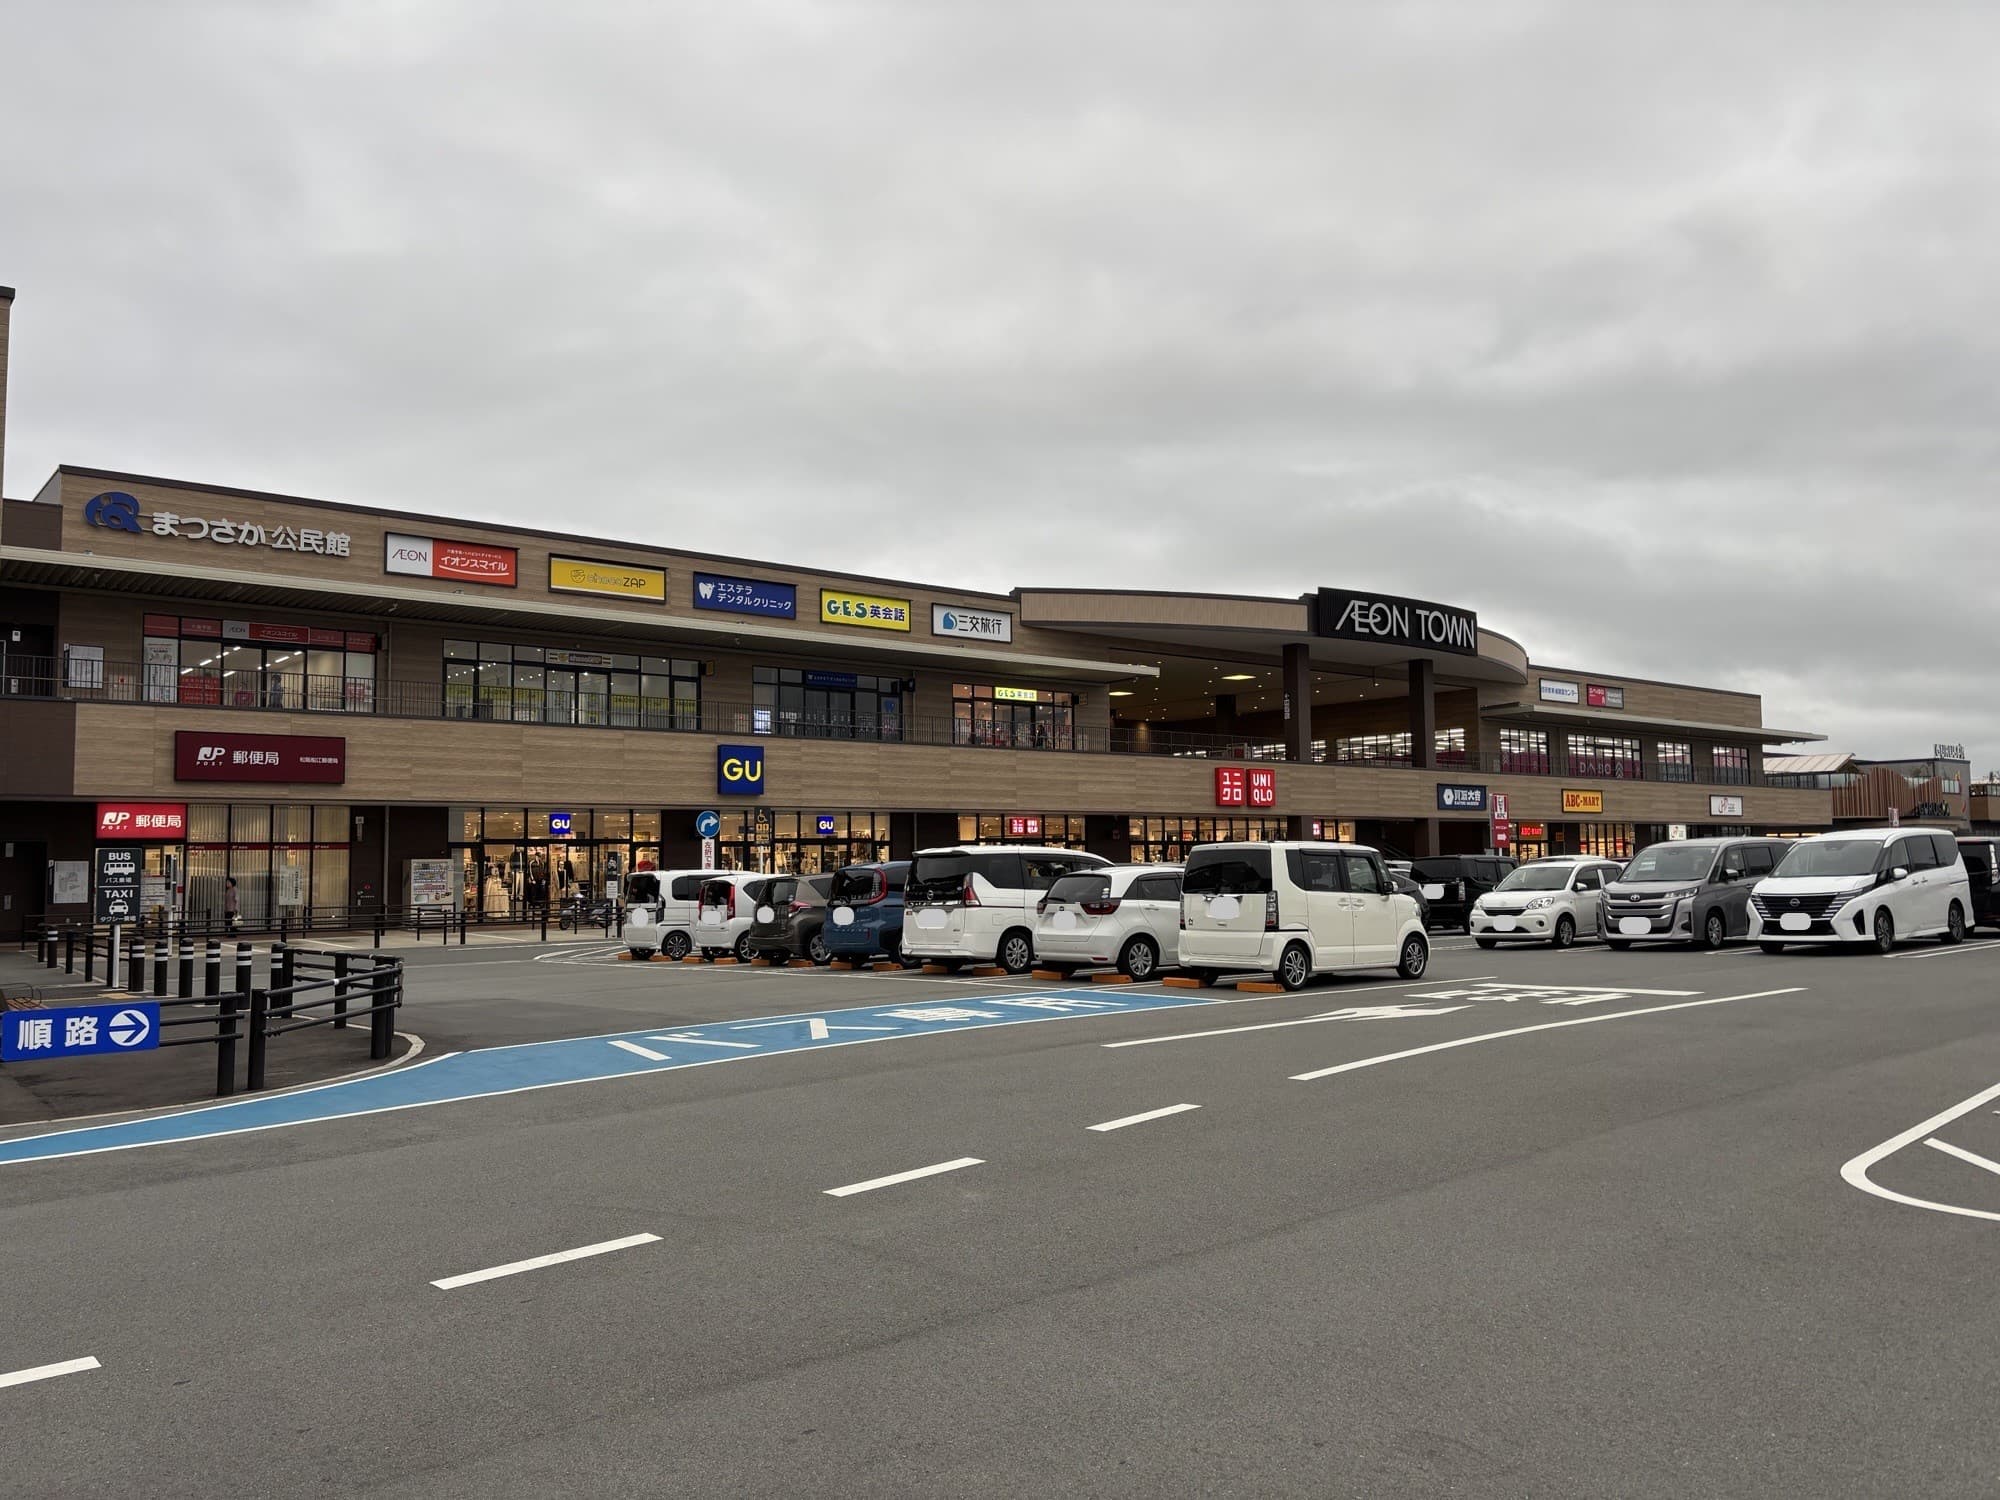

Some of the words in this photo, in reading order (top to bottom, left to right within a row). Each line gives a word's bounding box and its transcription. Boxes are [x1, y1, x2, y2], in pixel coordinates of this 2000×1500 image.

[152, 512, 351, 557] まつさか公民館
[440, 555, 508, 572] イオンスマイル
[717, 582, 753, 596] エステラ
[717, 592, 792, 611] デンタルクリニック
[958, 614, 1002, 635] 三交旅行
[1415, 608, 1475, 649] TOWN
[233, 750, 280, 766] 郵便局
[722, 758, 762, 782] GU
[1222, 772, 1242, 785] ユニ
[1252, 773, 1271, 787] UNI
[1222, 787, 1242, 801] クロ
[1253, 788, 1273, 804] QLO
[1565, 793, 1600, 808] ABC-MART
[135, 814, 182, 829] 郵便局
[552, 819, 570, 829] GU
[818, 820, 834, 830] GU
[108, 852, 132, 861] BUS
[104, 889, 133, 898] TAXI
[17, 1015, 98, 1051] 順路
